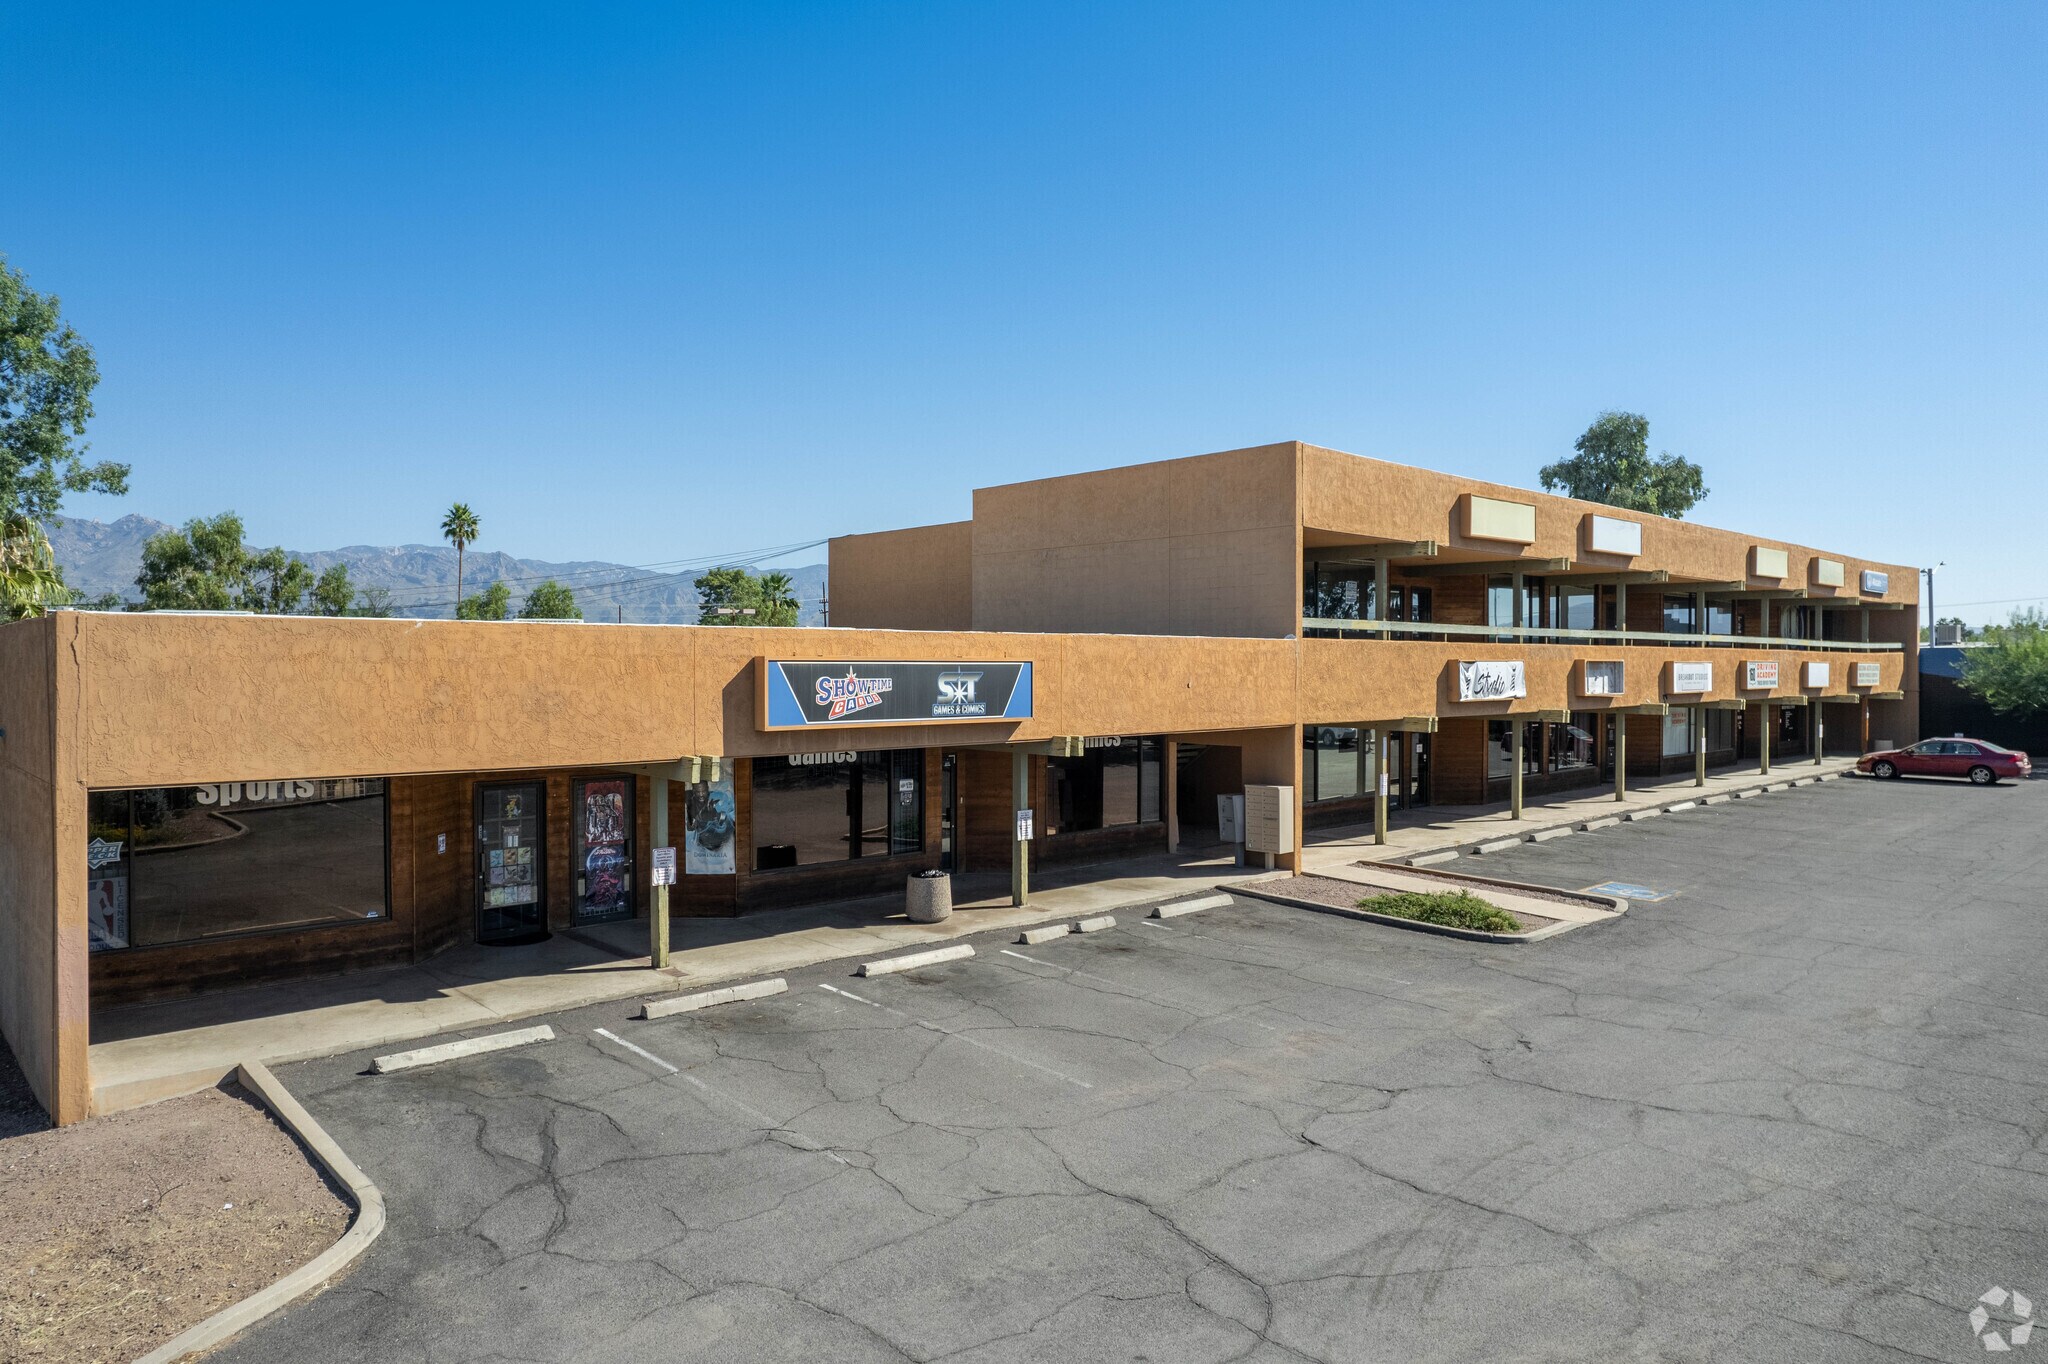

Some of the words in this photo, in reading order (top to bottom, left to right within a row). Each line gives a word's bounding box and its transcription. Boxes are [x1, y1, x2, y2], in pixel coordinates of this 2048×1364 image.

[1756, 663, 1777, 671] DRIVING
[1757, 671, 1777, 679] ACADEMY
[816, 677, 893, 706] SHOWTIME
[831, 693, 884, 718] CARDS
[933, 705, 954, 715] GAMES
[956, 705, 962, 715] &
[963, 704, 985, 714] COMICS
